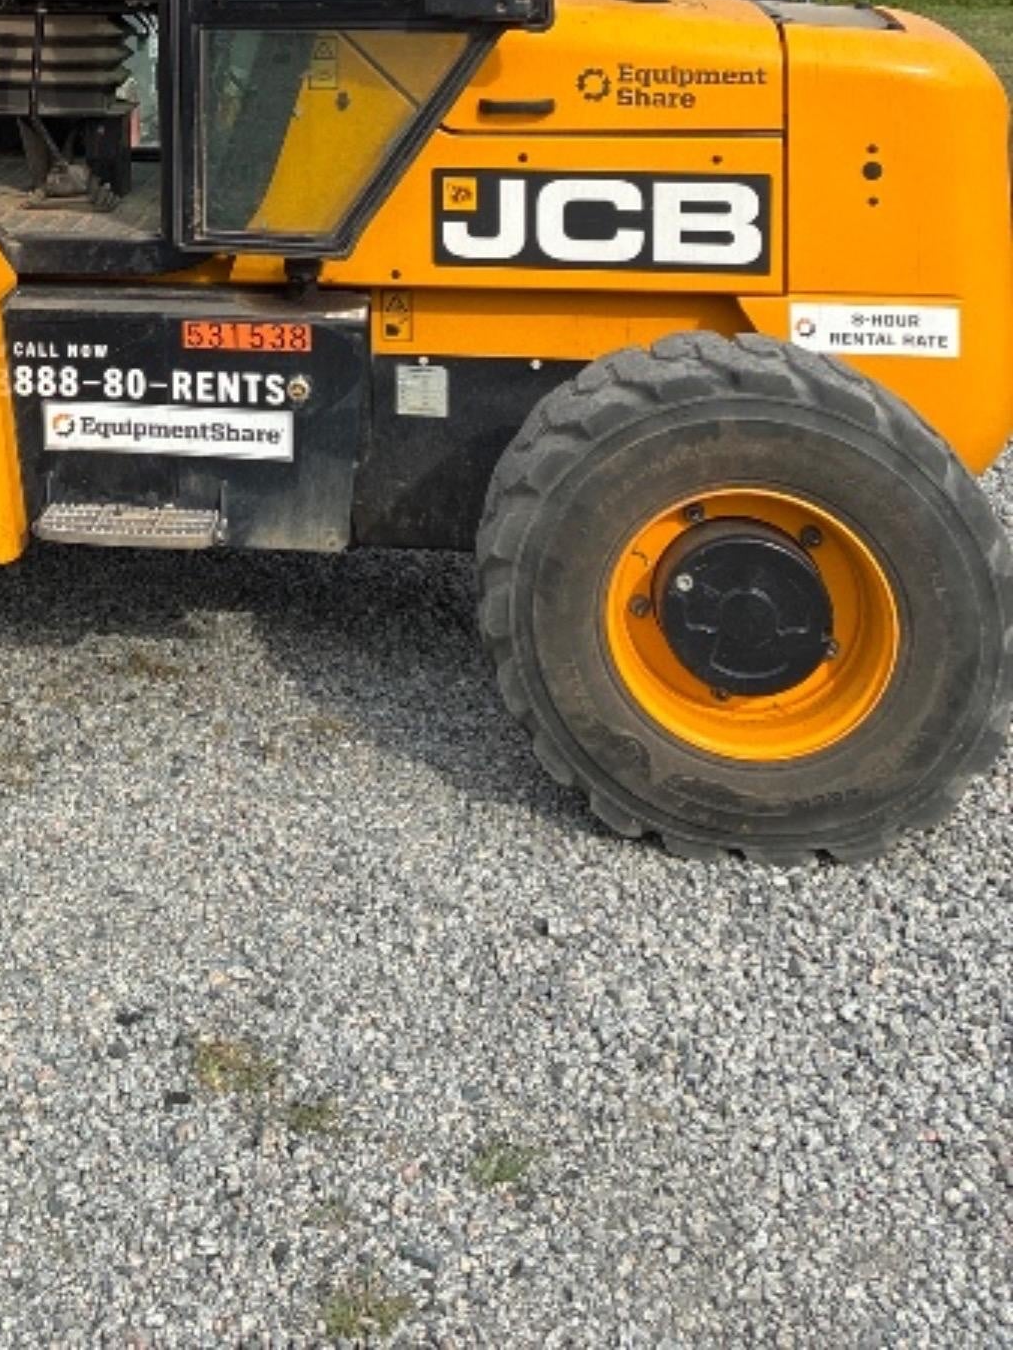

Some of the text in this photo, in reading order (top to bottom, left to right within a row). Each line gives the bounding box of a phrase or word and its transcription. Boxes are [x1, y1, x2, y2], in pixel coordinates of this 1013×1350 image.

[616, 63, 768, 87] Equipment
[616, 87, 697, 109] Share
[442, 177, 763, 266] JCB
[851, 312, 921, 328] 8-HOUR
[187, 323, 307, 349] 531538
[829, 332, 949, 349] RENTAL RATE
[13, 341, 108, 359] CALL NOW
[14, 365, 286, 405] 888-80-RENTS
[80, 416, 282, 445] EquipmentShare
